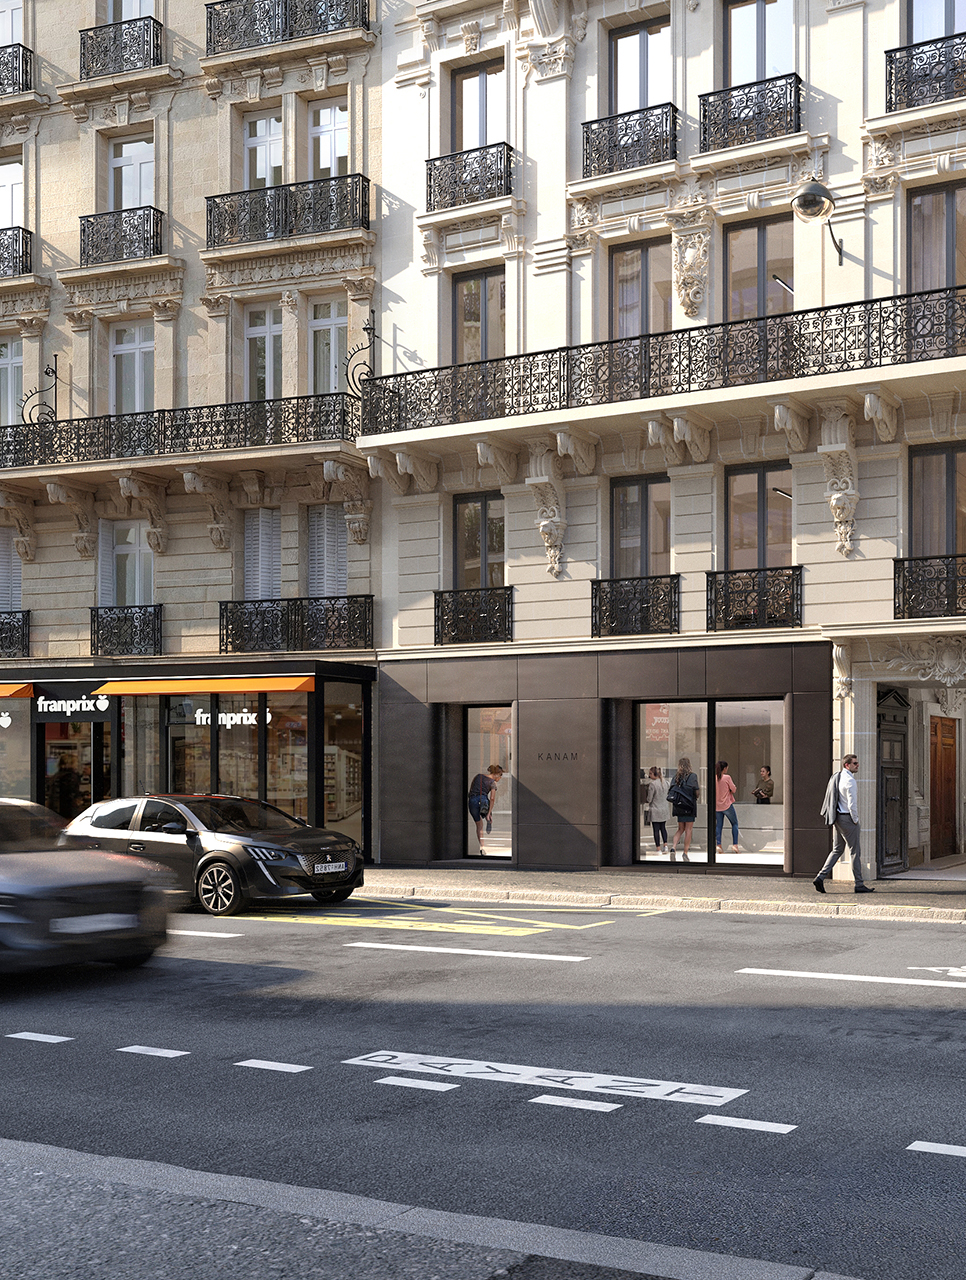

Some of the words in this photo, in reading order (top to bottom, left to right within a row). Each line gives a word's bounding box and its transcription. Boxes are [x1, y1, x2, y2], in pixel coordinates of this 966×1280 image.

[37, 694, 96, 716] franprix
[537, 752, 578, 761] KANAM
[359, 1053, 727, 1100] PAYANT
